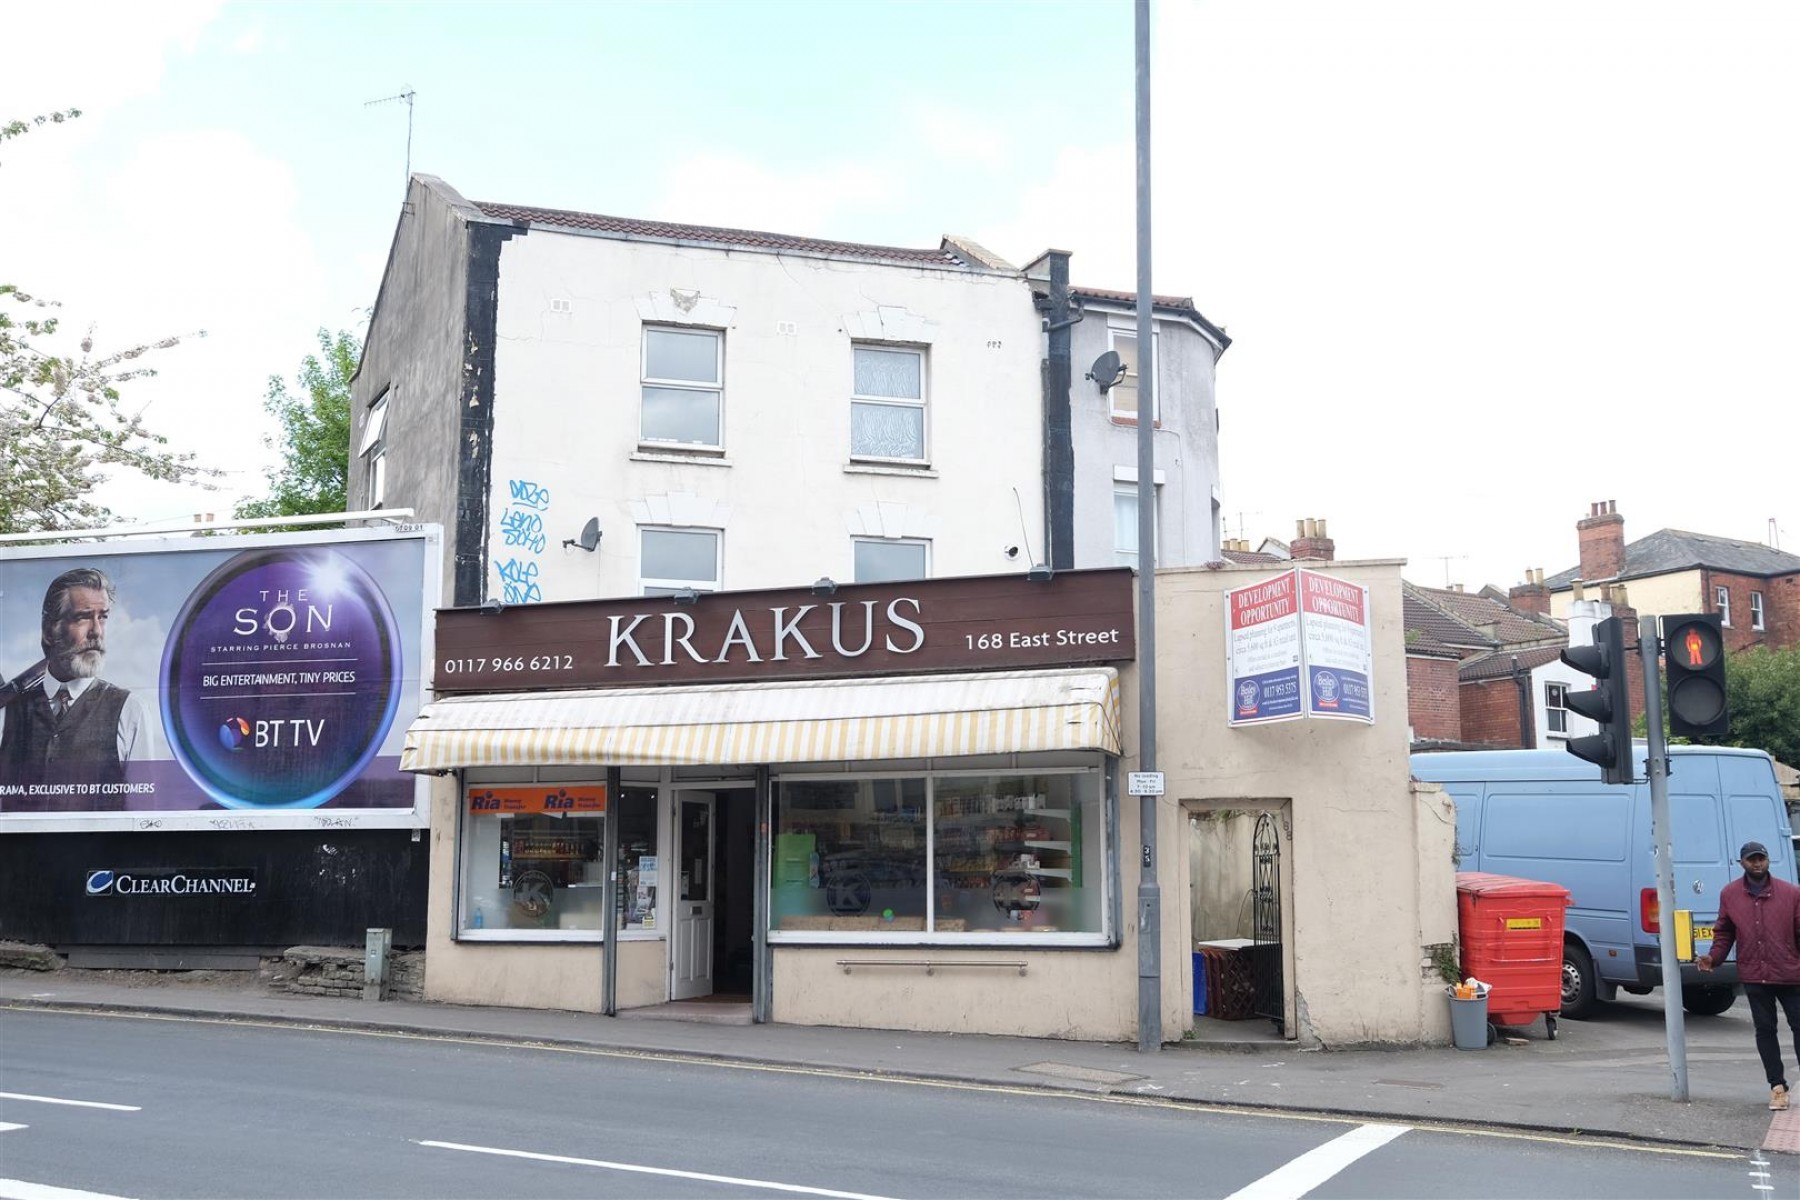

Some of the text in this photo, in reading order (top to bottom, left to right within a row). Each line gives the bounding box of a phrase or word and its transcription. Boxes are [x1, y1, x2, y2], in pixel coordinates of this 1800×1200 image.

[259, 589, 309, 602] THE
[1238, 577, 1290, 608] DEVELOPMENT
[1308, 576, 1359, 605] DEVELOPMENT
[1240, 596, 1290, 626] OPPORTUNITY
[1311, 595, 1359, 622] OPPORTUNITY
[233, 604, 333, 636] SON
[603, 597, 926, 668] KRAKUS
[965, 629, 1119, 650] 168 East Street
[210, 642, 351, 653] STARRING PIERCE BROSNAN
[445, 655, 573, 674] 0117 966 6212
[202, 675, 219, 687] BIG
[299, 671, 321, 684] TINY
[322, 670, 355, 683] PRICES
[255, 719, 325, 747] BT TV
[29, 784, 75, 795] EXCLUSIVE
[76, 784, 88, 795] TO
[89, 784, 101, 794] BT
[102, 783, 155, 794] CUSTOMERS
[543, 789, 575, 809] Ria
[471, 791, 501, 810] Ria
